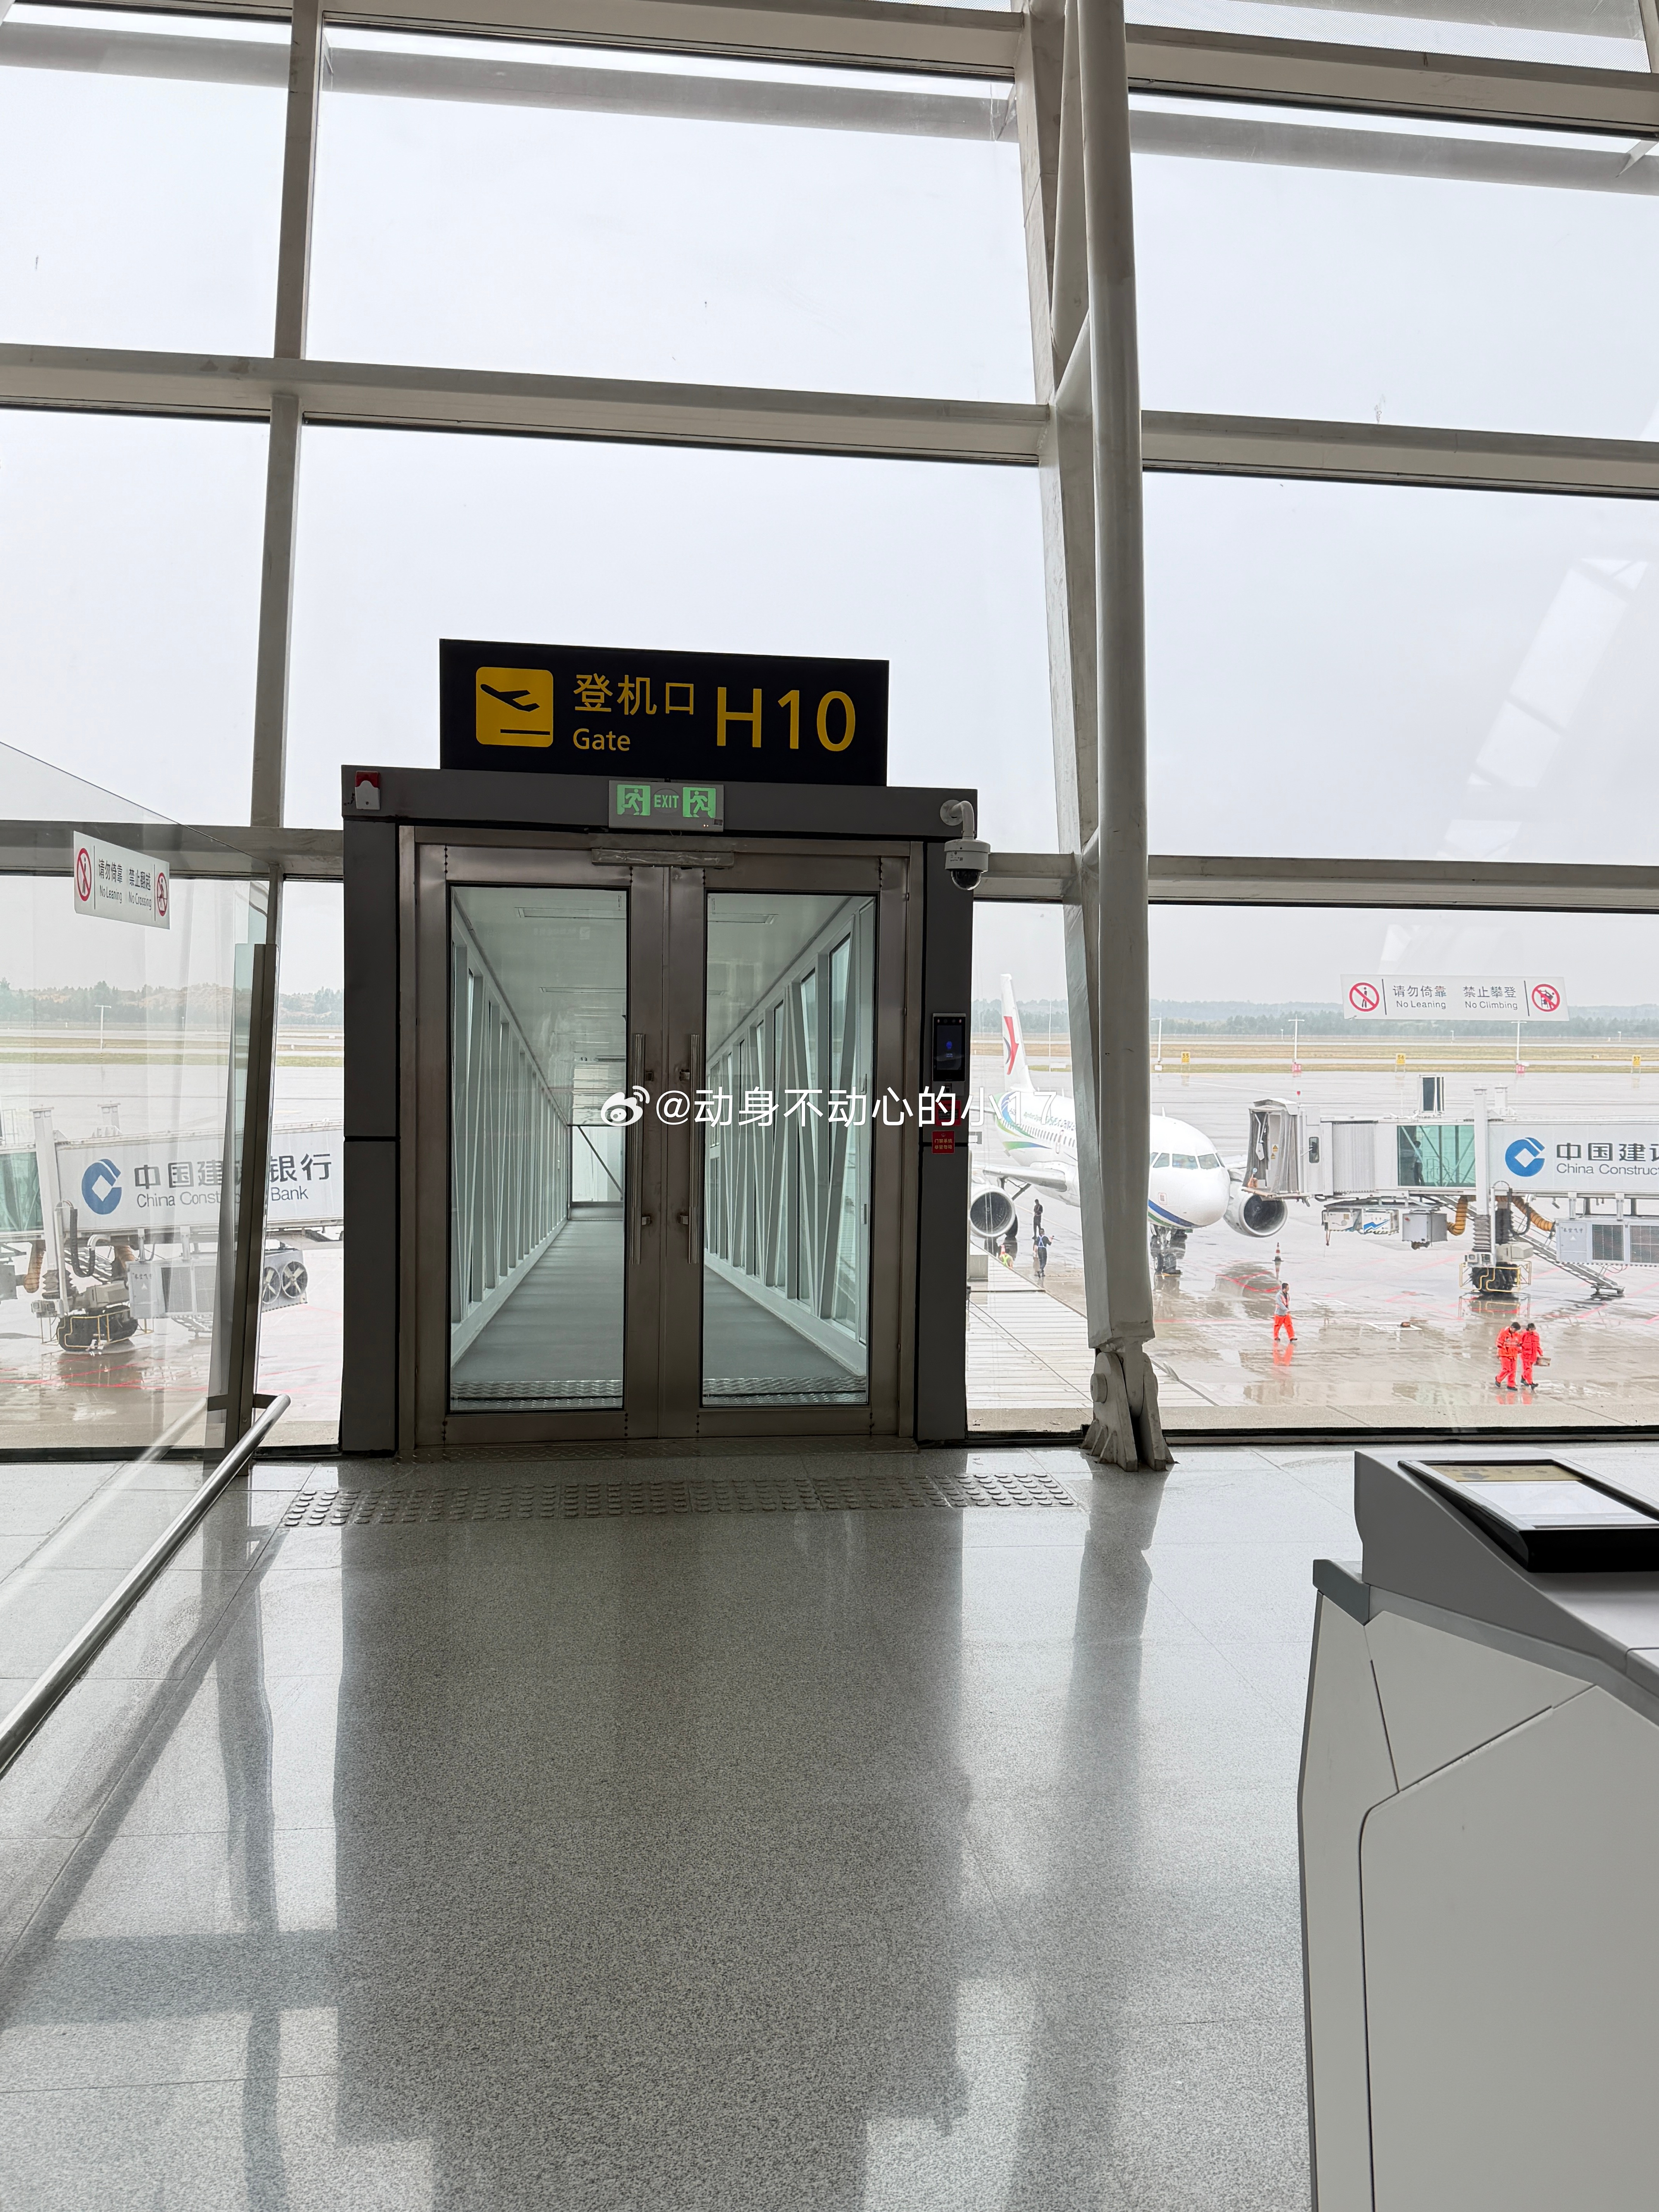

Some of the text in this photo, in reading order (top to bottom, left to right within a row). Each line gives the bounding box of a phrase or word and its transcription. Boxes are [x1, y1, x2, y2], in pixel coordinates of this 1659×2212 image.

[573, 673, 695, 715] 登机口
[716, 687, 856, 751] H10
[573, 728, 630, 751] Gate
[654, 794, 679, 808] EXIT
[99, 859, 122, 883] 请勿倚靠
[100, 885, 122, 903] No Leaning
[129, 891, 151, 910] No Crossing
[1393, 985, 1446, 997] 请勿倚靠
[1463, 986, 1516, 998] 禁止攀登
[1411, 1000, 1446, 1009] Leaning
[1480, 1001, 1518, 1010] Climbing
[1556, 1163, 1659, 1175] China Construc
[137, 1193, 175, 1208] China
[271, 1185, 309, 1201] Bank
